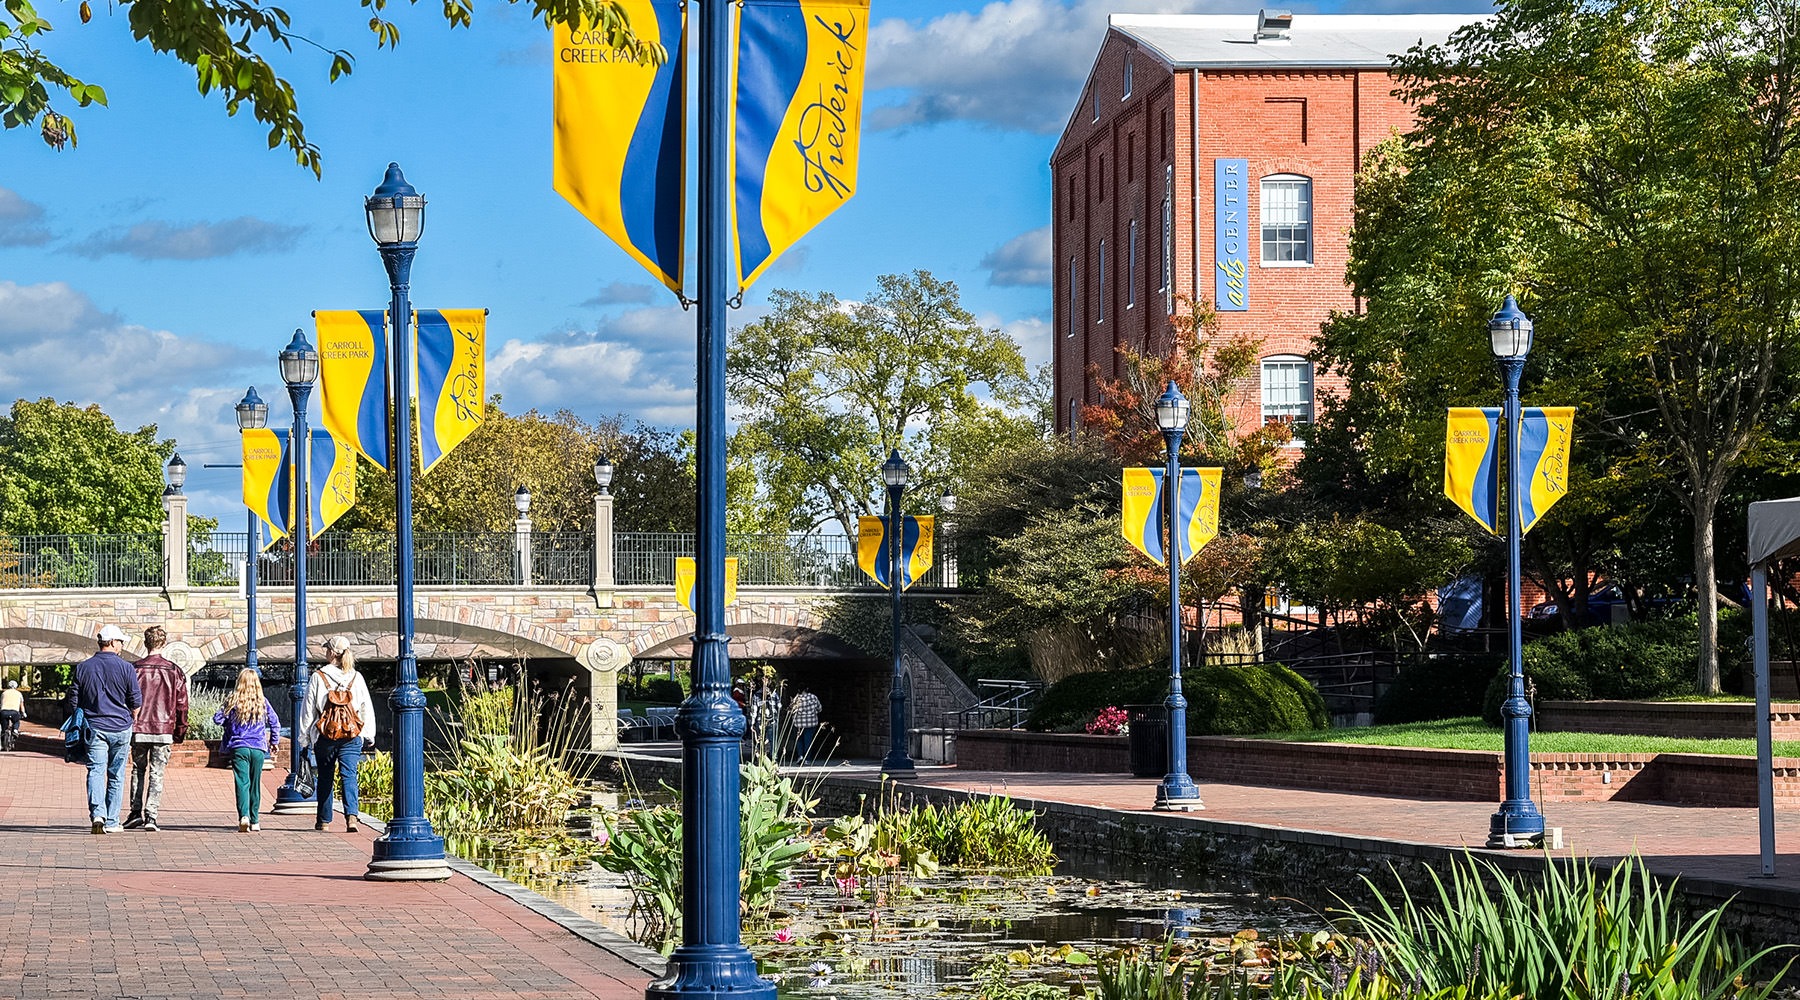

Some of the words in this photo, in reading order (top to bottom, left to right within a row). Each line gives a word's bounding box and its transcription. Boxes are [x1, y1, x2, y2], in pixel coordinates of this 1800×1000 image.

[560, 47, 608, 63] CREEK
[570, 30, 609, 45] CARR
[792, 8, 859, 200] Frederick
[1224, 162, 1239, 255] CENTER
[1217, 257, 1246, 307] arts
[321, 350, 348, 359] CREEK
[349, 350, 369, 359] PARK
[326, 341, 364, 350] CARROLL
[450, 325, 483, 424] Frederick
[1449, 436, 1468, 444] CREEK
[1541, 416, 1569, 495] Frederick
[332, 440, 354, 506] Frederick
[1197, 477, 1218, 536] Frederick
